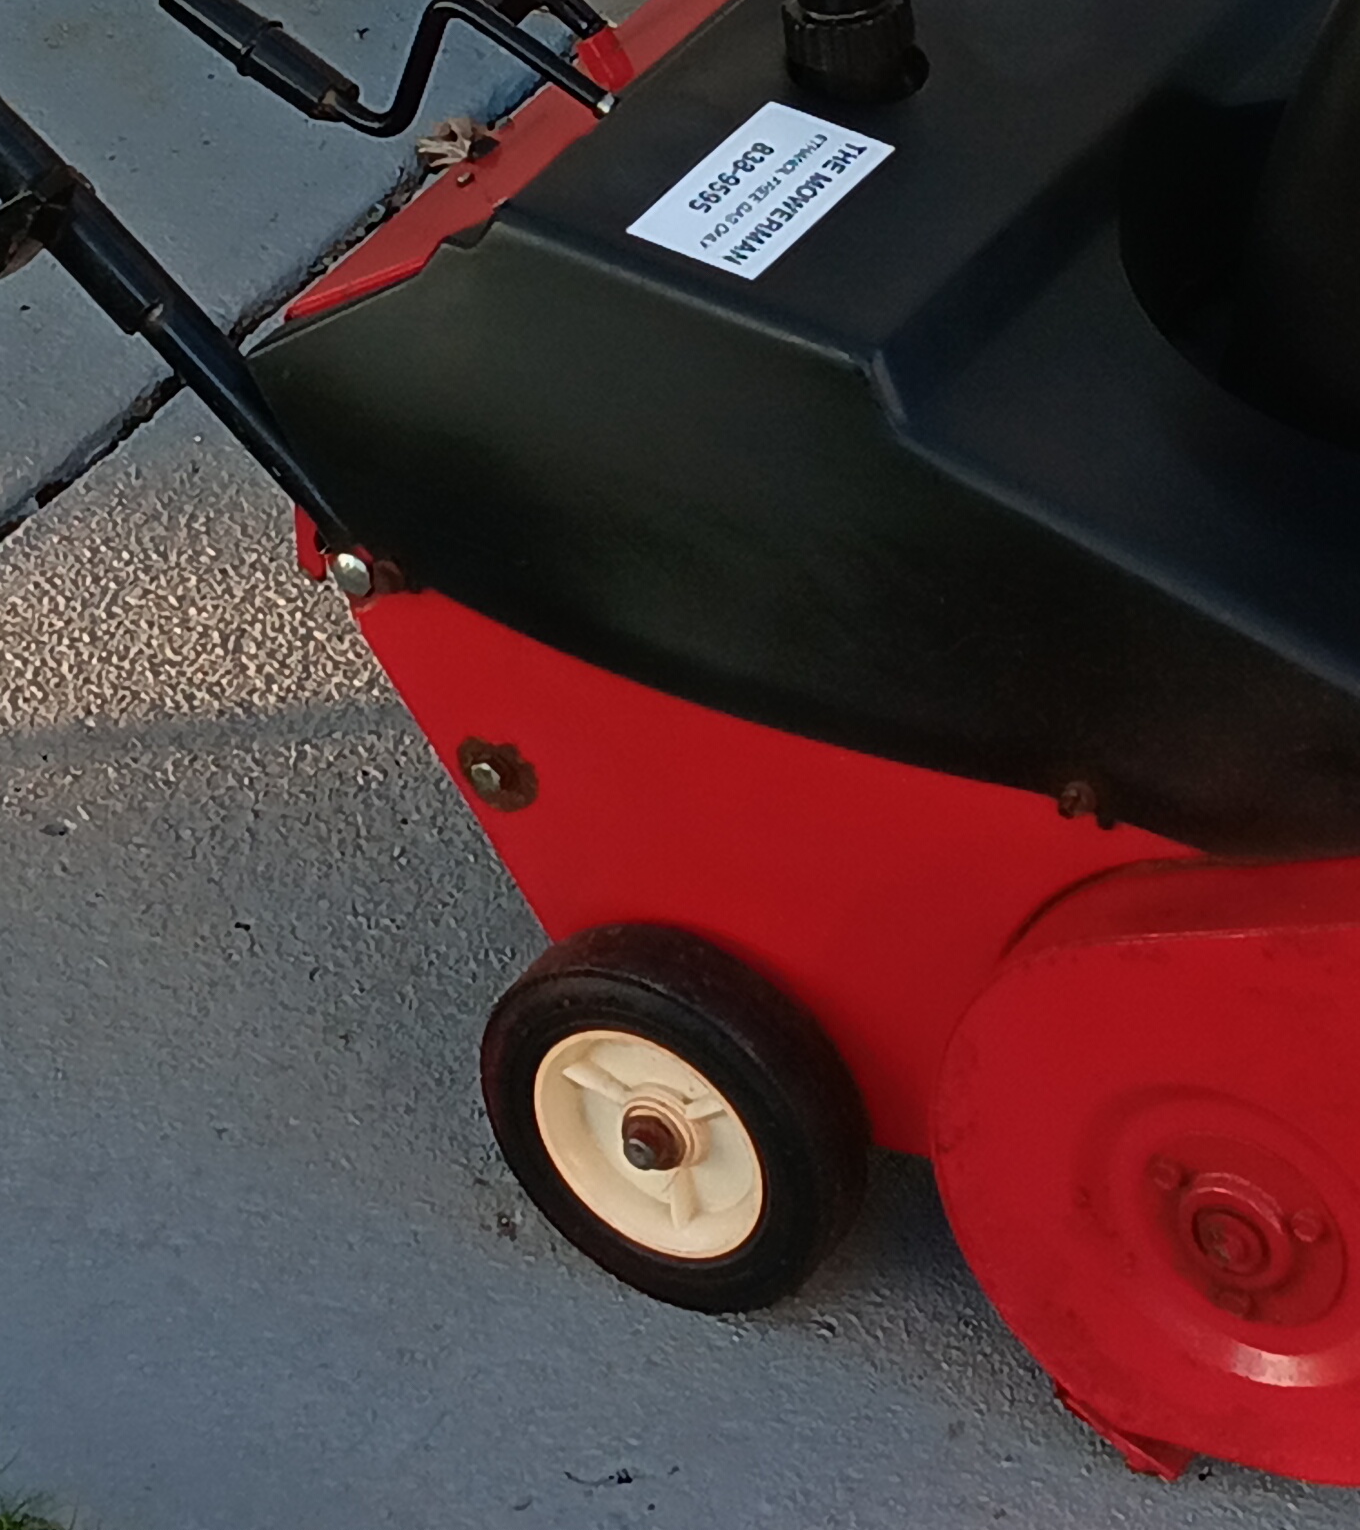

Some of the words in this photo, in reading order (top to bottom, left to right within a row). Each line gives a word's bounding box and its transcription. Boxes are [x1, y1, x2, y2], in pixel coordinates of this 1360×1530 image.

[688, 142, 775, 214] 838-9595
[822, 143, 868, 175] THE
[722, 172, 833, 266] MOWERMAN
